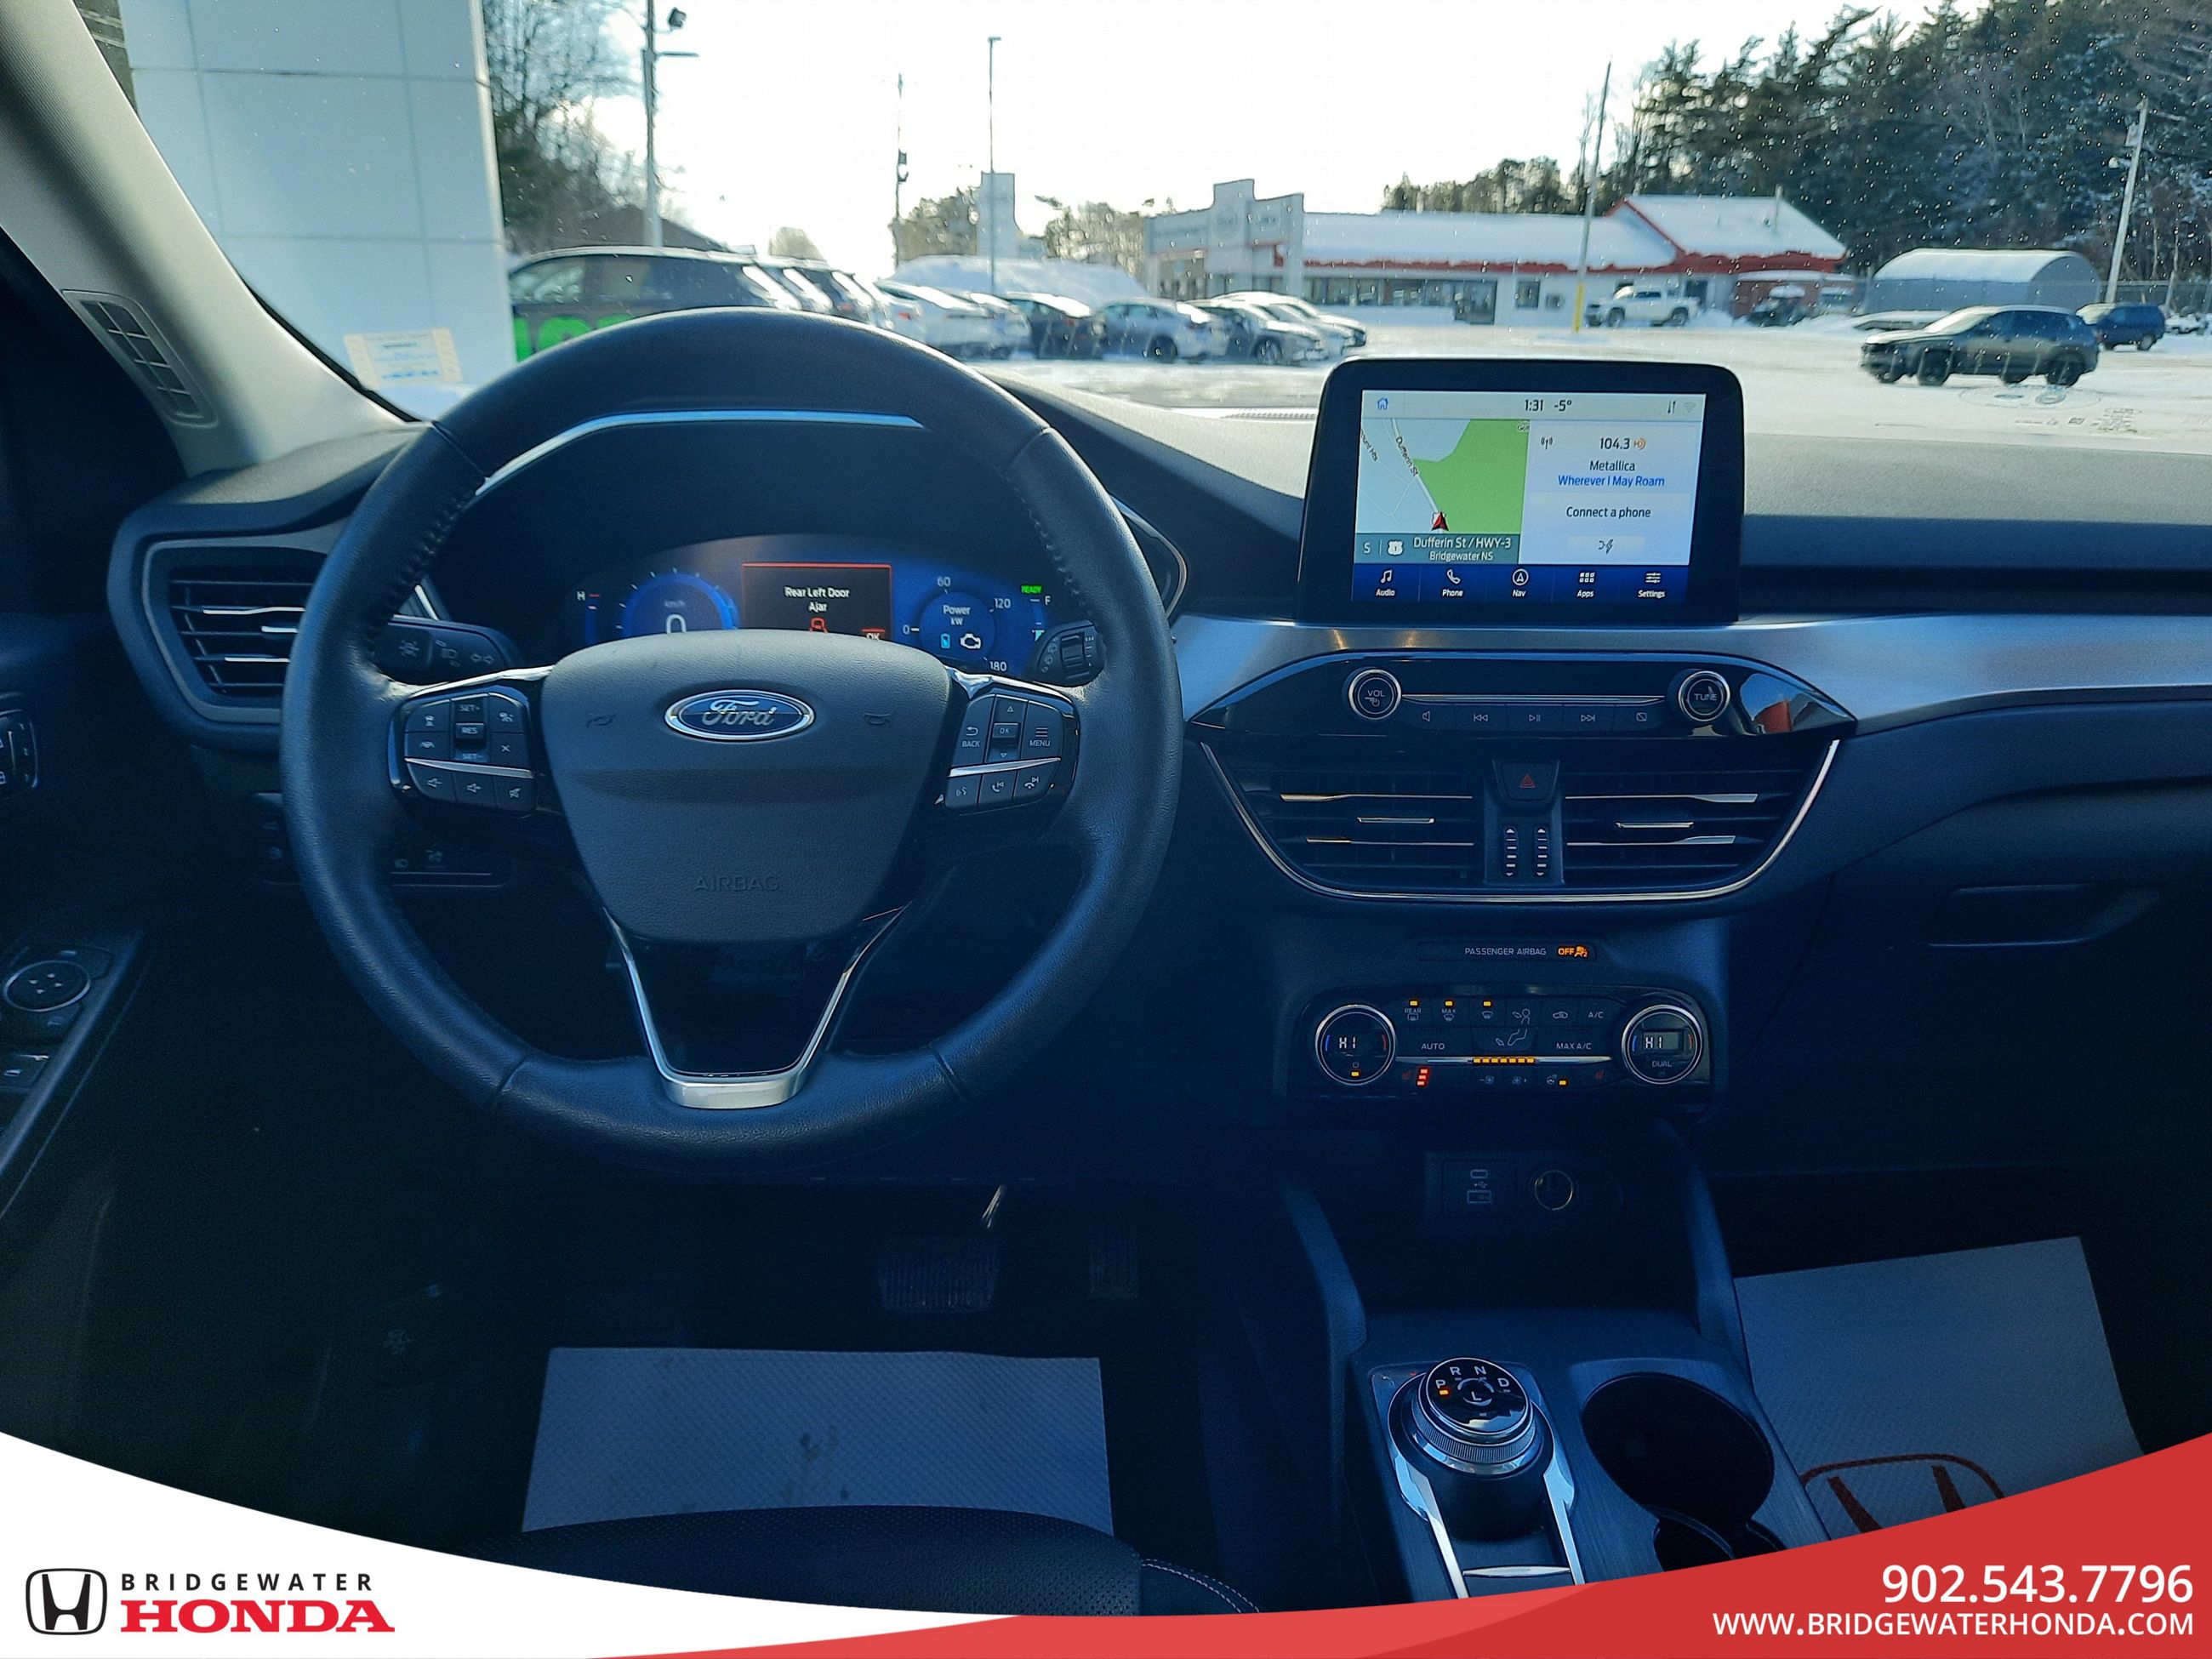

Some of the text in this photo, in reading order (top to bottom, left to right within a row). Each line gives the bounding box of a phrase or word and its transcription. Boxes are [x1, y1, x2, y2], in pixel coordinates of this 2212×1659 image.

[1525, 399, 1543, 412] 1:31
[1599, 437, 1630, 450] 104.3
[1395, 436, 1419, 476] Dufferin St
[1589, 459, 1636, 471] Metallica
[1558, 475, 1606, 486] Wherever
[1611, 476, 1634, 488] May
[1635, 476, 1666, 487] Roam
[1566, 506, 1608, 517] Connect
[1618, 507, 1651, 520] phone
[1364, 542, 1371, 554] S
[1413, 537, 1452, 549] Dufferin
[1455, 537, 1468, 549] St
[1475, 537, 1512, 549] HWY-3
[1429, 551, 1493, 562] Bridgewater NS
[937, 576, 951, 587] 60
[784, 586, 850, 598] Rear Left Door
[1576, 590, 1594, 599] Apps
[1638, 590, 1666, 598] Settings
[808, 601, 828, 613] Ajar
[995, 598, 1011, 608] 120
[1045, 596, 1051, 606] F
[943, 604, 971, 615] Power
[951, 617, 963, 626] kW
[903, 624, 910, 635] 0
[989, 661, 1007, 672] 180
[702, 699, 777, 726] Ford
[693, 877, 780, 892] AIRBAG
[1339, 1036, 1356, 1049] HI
[1645, 1036, 1662, 1049] HI
[1435, 1365, 1510, 1389] P R N D
[1471, 1391, 1482, 1401] L
